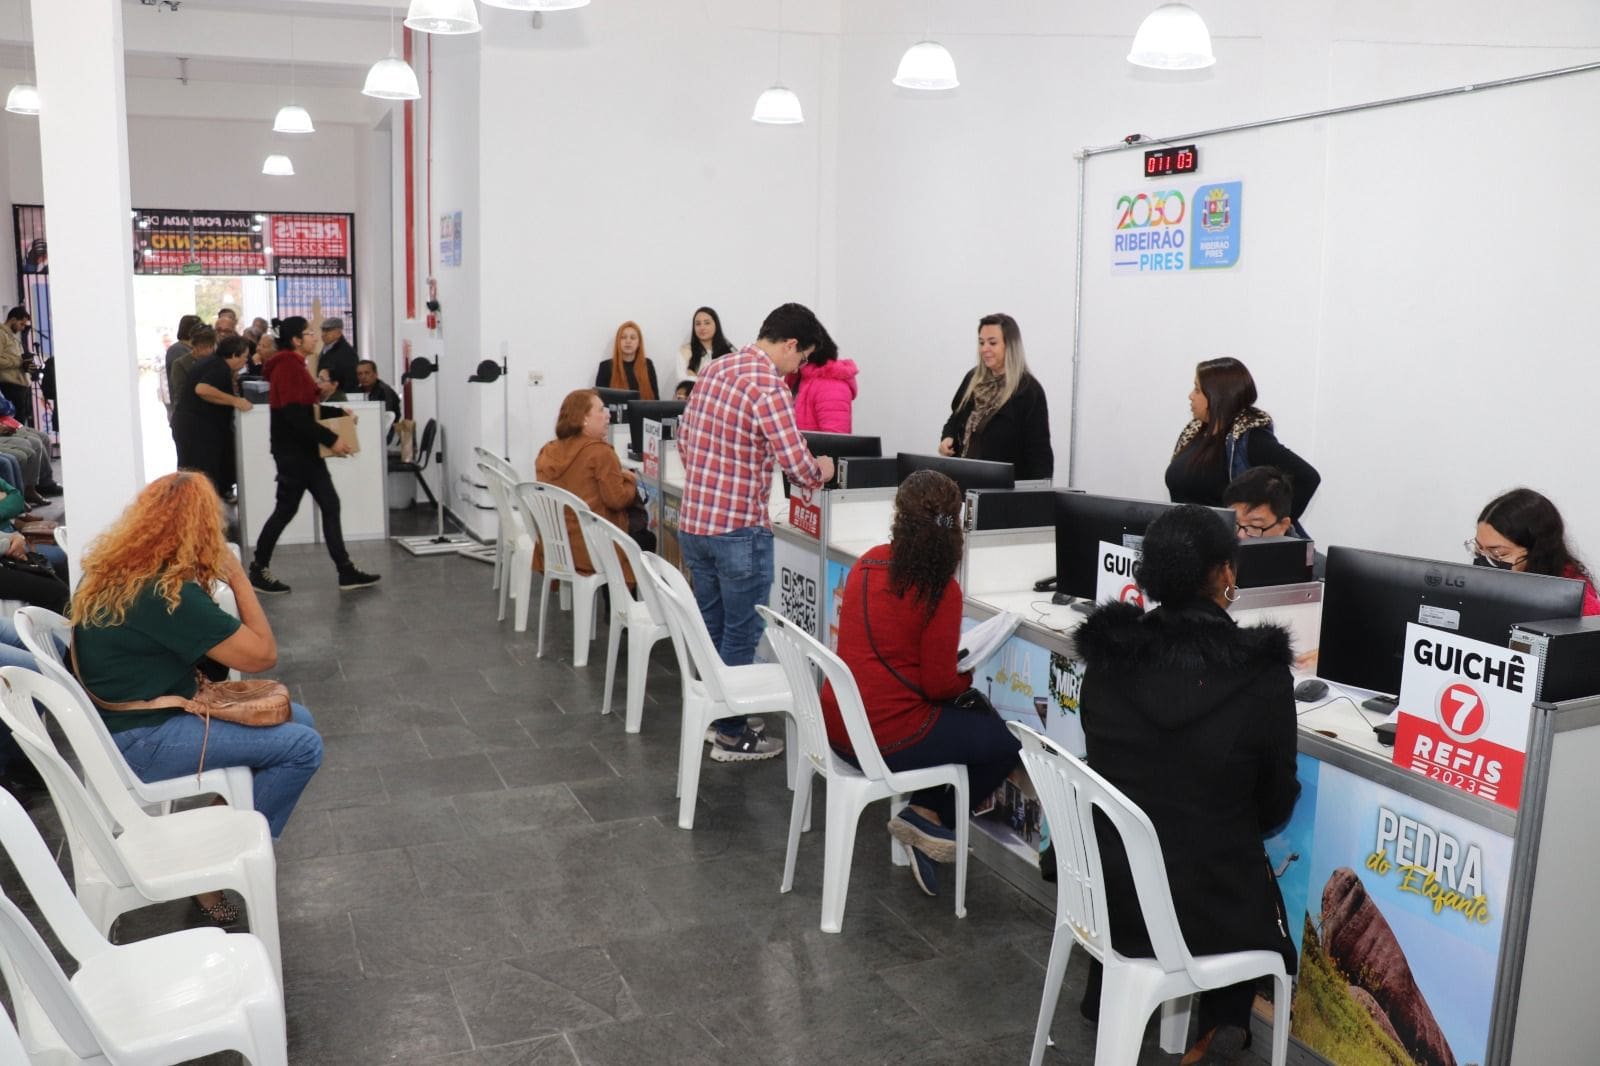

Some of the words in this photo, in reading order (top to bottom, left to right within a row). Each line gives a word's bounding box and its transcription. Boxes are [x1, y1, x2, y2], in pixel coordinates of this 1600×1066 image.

[1177, 152, 1193, 169] 03
[1116, 189, 1185, 230] 2030
[1114, 227, 1185, 252] RIBEIRÃO
[1140, 251, 1185, 272] PIRES
[794, 505, 818, 526] REFIS
[1445, 576, 1465, 588] LG
[1414, 639, 1525, 693] GUICHÊ
[1450, 688, 1478, 732] 7
[1413, 734, 1503, 784] REFIS
[1430, 766, 1477, 793] 2023
[1376, 807, 1482, 897] PEDRA
[1366, 848, 1391, 875] do
[1397, 865, 1490, 924] Elefante
